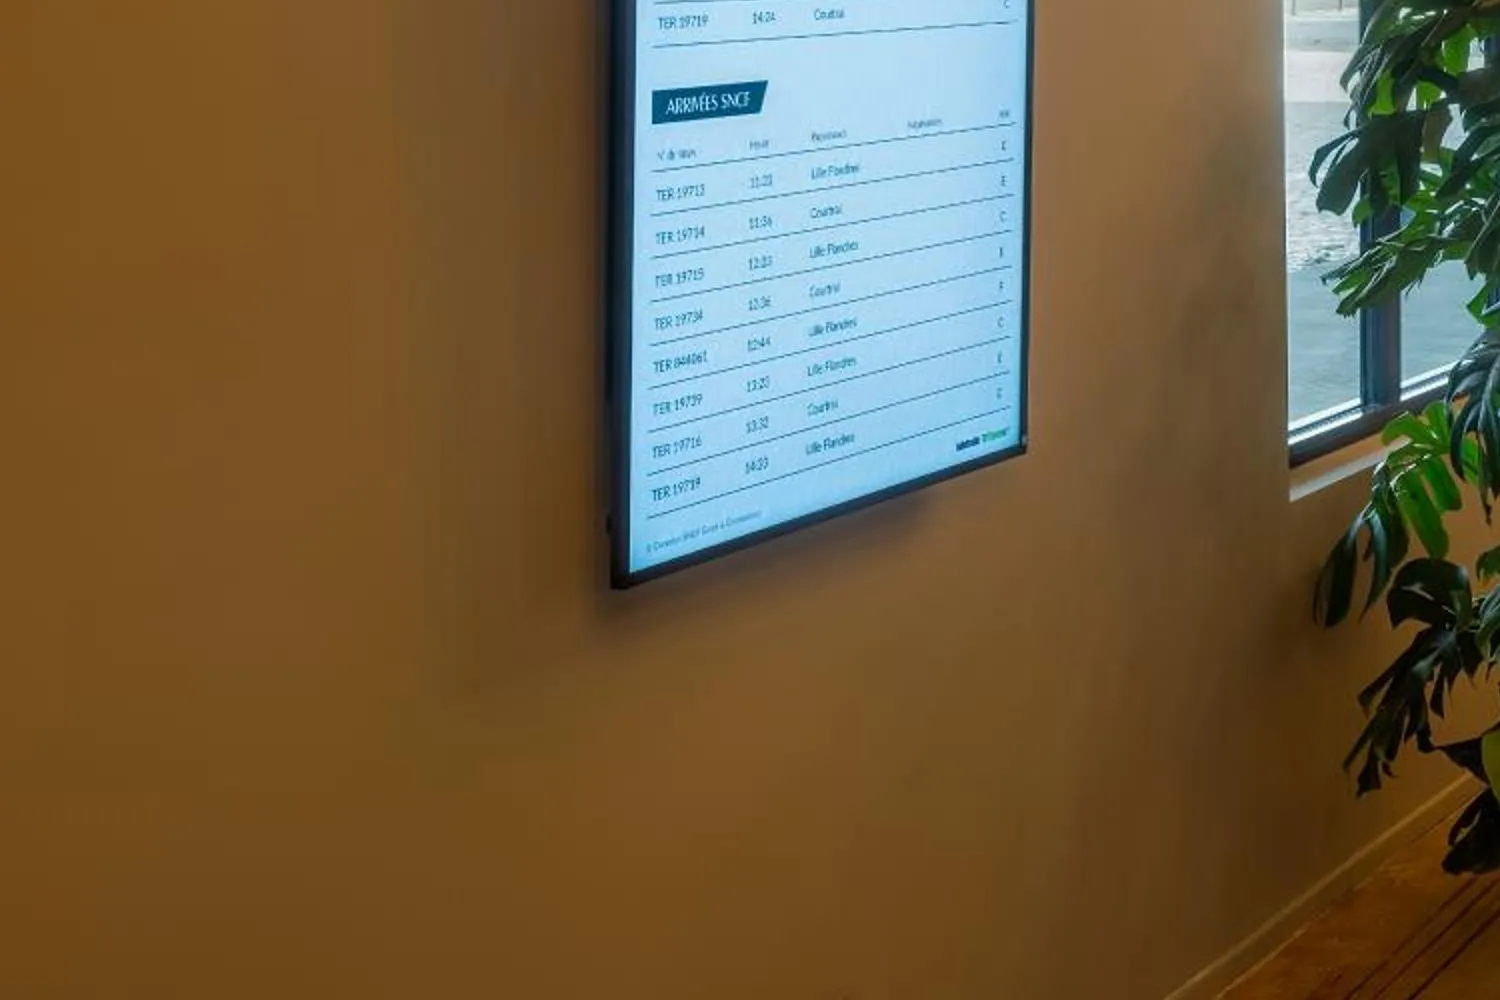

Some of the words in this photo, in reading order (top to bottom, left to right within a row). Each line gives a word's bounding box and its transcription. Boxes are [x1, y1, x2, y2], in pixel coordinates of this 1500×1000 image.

[658, 16, 677, 30] TER
[665, 91, 719, 115] ARRIVÉES
[721, 91, 751, 109] SNCF
[656, 186, 674, 201] TER
[656, 231, 673, 245] TER
[656, 274, 673, 288] TER
[655, 316, 673, 330] TER
[653, 358, 672, 373] TER
[653, 401, 673, 416] TER
[652, 443, 671, 459] TER
[652, 486, 671, 502] TER
